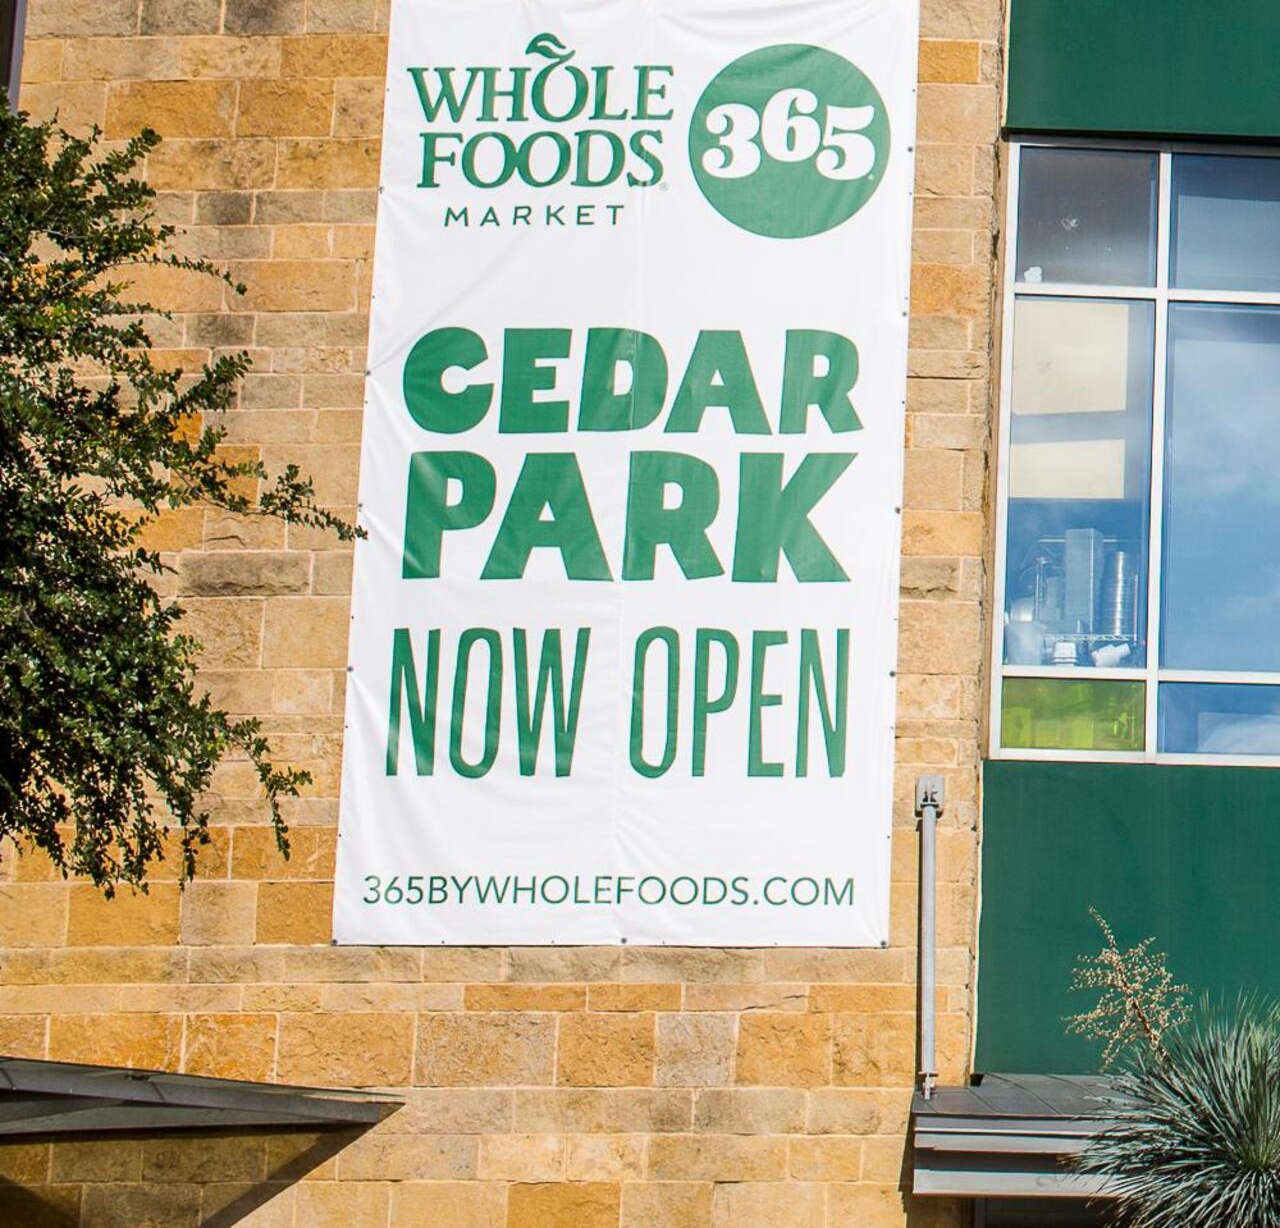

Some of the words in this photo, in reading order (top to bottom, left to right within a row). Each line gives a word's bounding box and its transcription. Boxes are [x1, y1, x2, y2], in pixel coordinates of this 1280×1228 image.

[407, 32, 675, 123] WHOLE
[416, 129, 664, 189] FOODS
[701, 87, 876, 181] 365
[444, 204, 625, 227] MARKET
[400, 327, 865, 436] CEDAR
[400, 450, 858, 584] PARK
[385, 627, 592, 780] NOW
[628, 626, 852, 780] OPEN
[363, 875, 855, 907] 365BYWHOLEFOODS.COM
